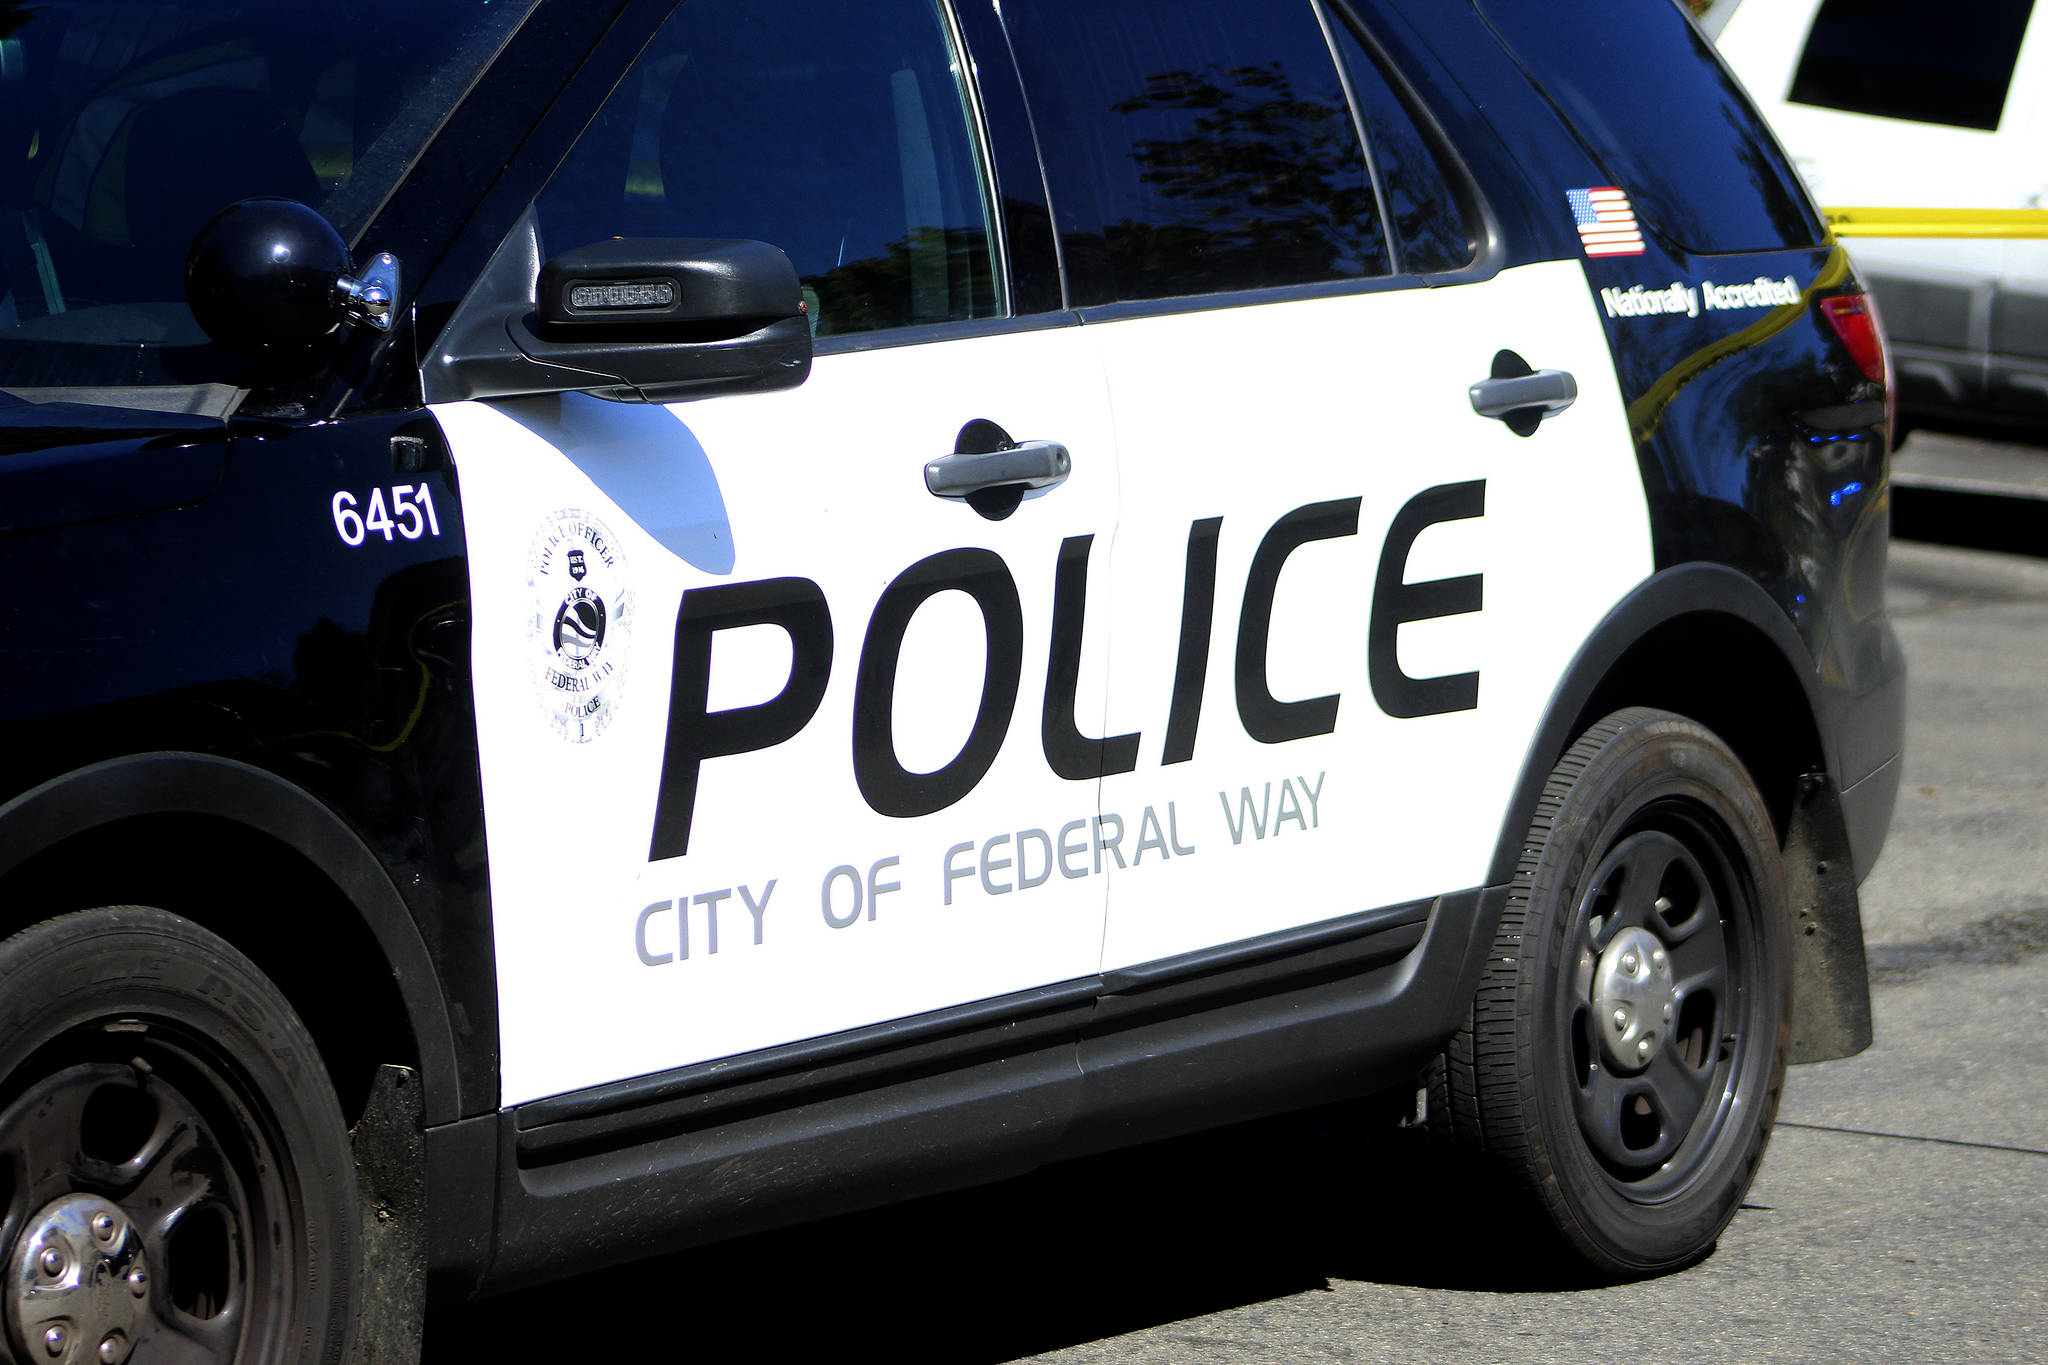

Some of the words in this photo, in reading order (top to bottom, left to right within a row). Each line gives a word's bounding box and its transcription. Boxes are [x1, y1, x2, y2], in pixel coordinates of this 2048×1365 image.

[1600, 281, 1700, 318] Nationally
[1701, 274, 1801, 311] Accredited
[332, 482, 440, 547] 6451
[568, 521, 614, 568] OFFICER
[564, 588, 583, 605] CITY
[584, 589, 598, 601] OF
[545, 667, 590, 692] FEDERAL
[647, 478, 1488, 864] POLICE
[564, 695, 601, 718] POLICE
[635, 879, 778, 967] CITY
[821, 856, 902, 930] OF
[944, 800, 1196, 906] FEDERAL
[1219, 771, 1326, 845] WAY
